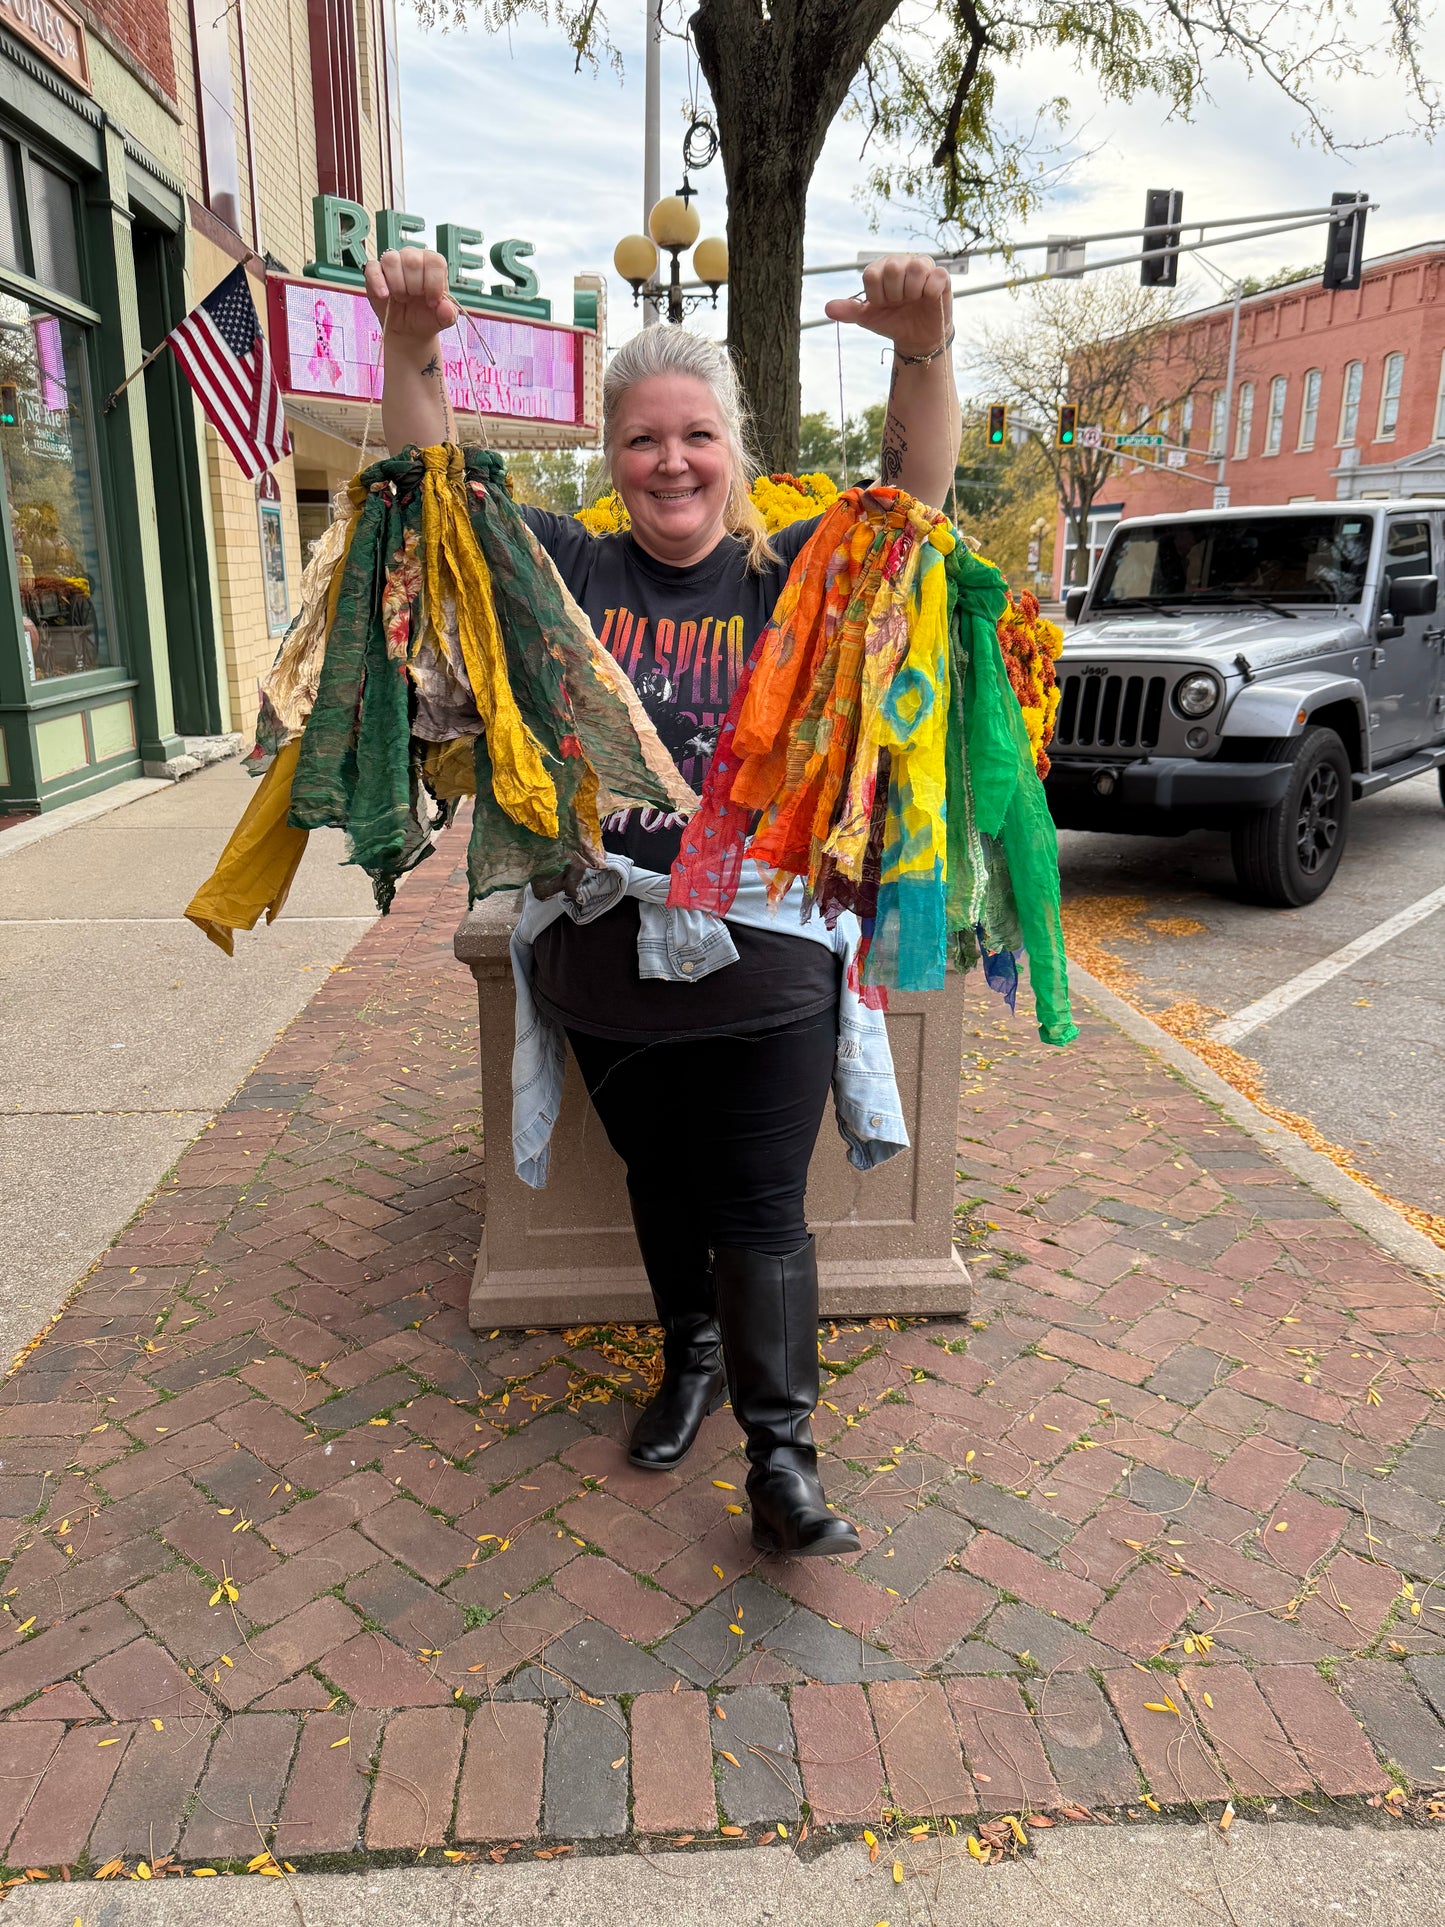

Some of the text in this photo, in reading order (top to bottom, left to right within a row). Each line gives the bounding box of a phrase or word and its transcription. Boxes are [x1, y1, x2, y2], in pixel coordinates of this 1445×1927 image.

[312, 194, 541, 300] REES
[467, 356, 524, 387] Cancer
[495, 382, 549, 418] Month
[600, 607, 744, 704] THE SPEED
[1081, 665, 1109, 677] Jeep
